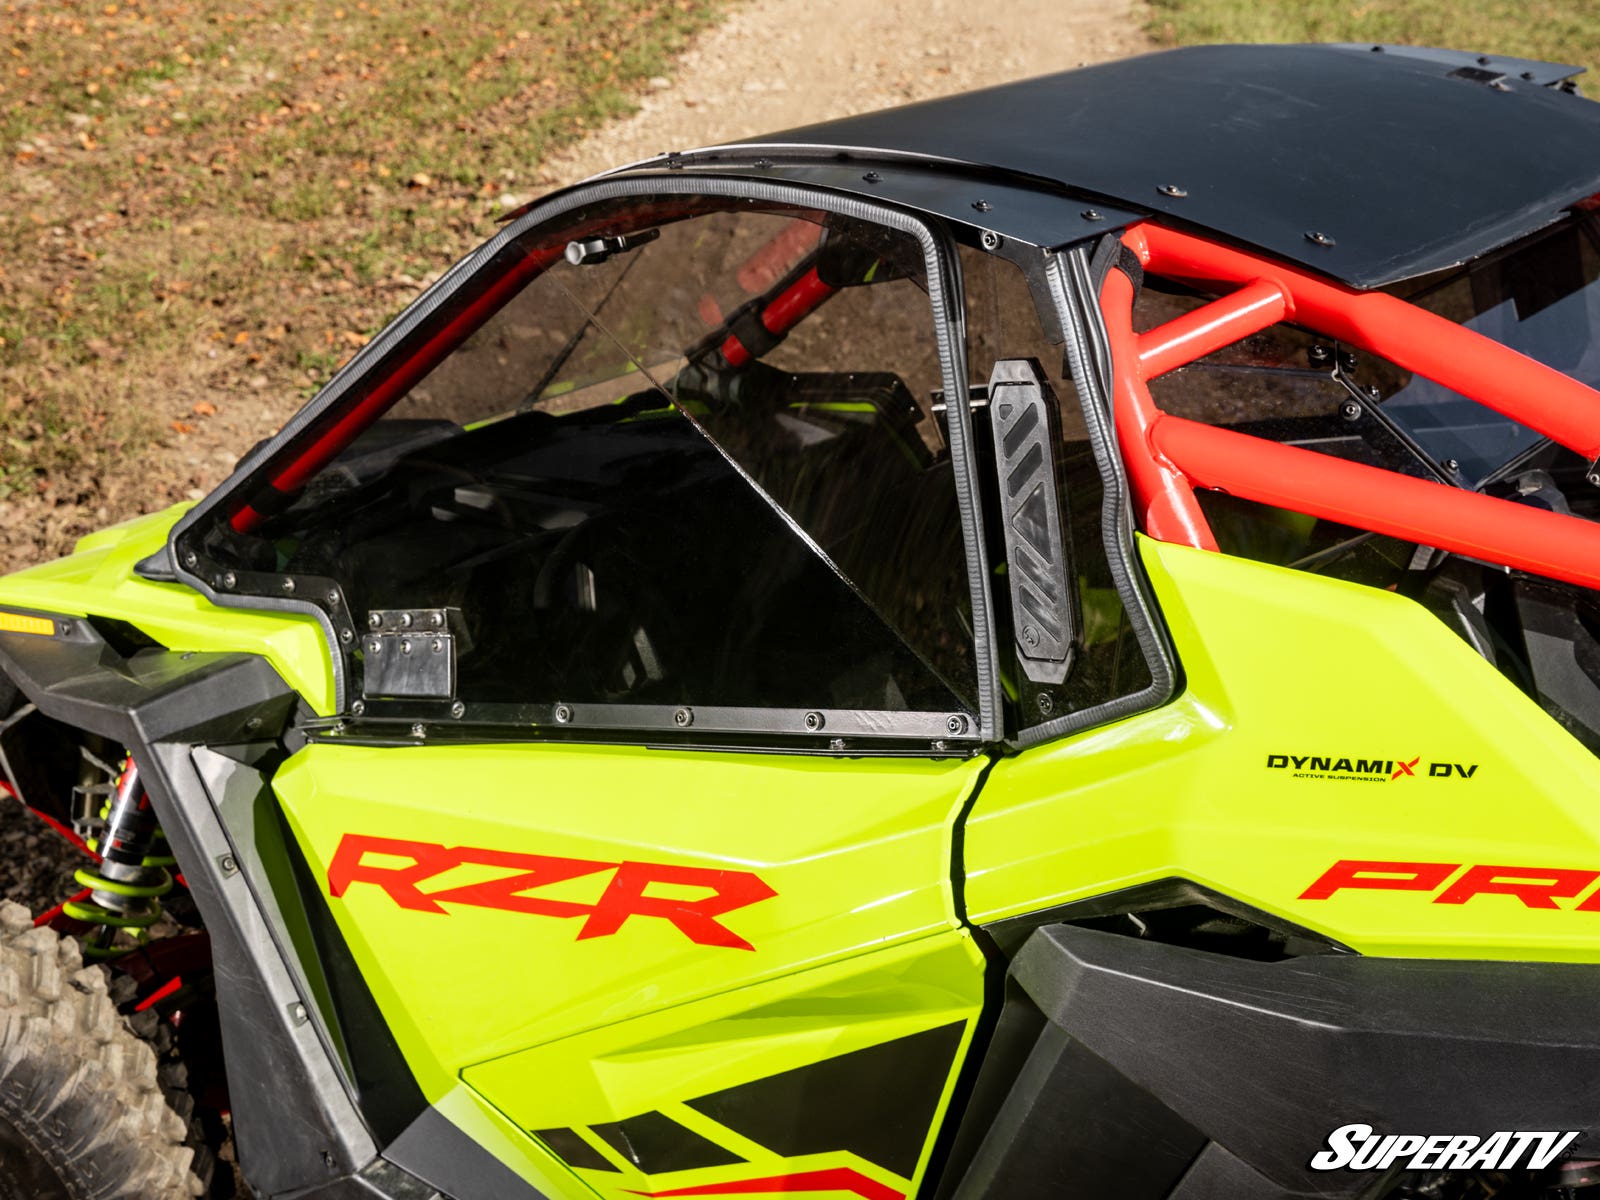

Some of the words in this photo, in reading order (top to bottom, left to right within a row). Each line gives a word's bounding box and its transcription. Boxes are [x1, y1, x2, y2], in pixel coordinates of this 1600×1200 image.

[1267, 754, 1420, 781] DYNAMIX
[1428, 763, 1479, 779] DV
[327, 833, 779, 952] RZR
